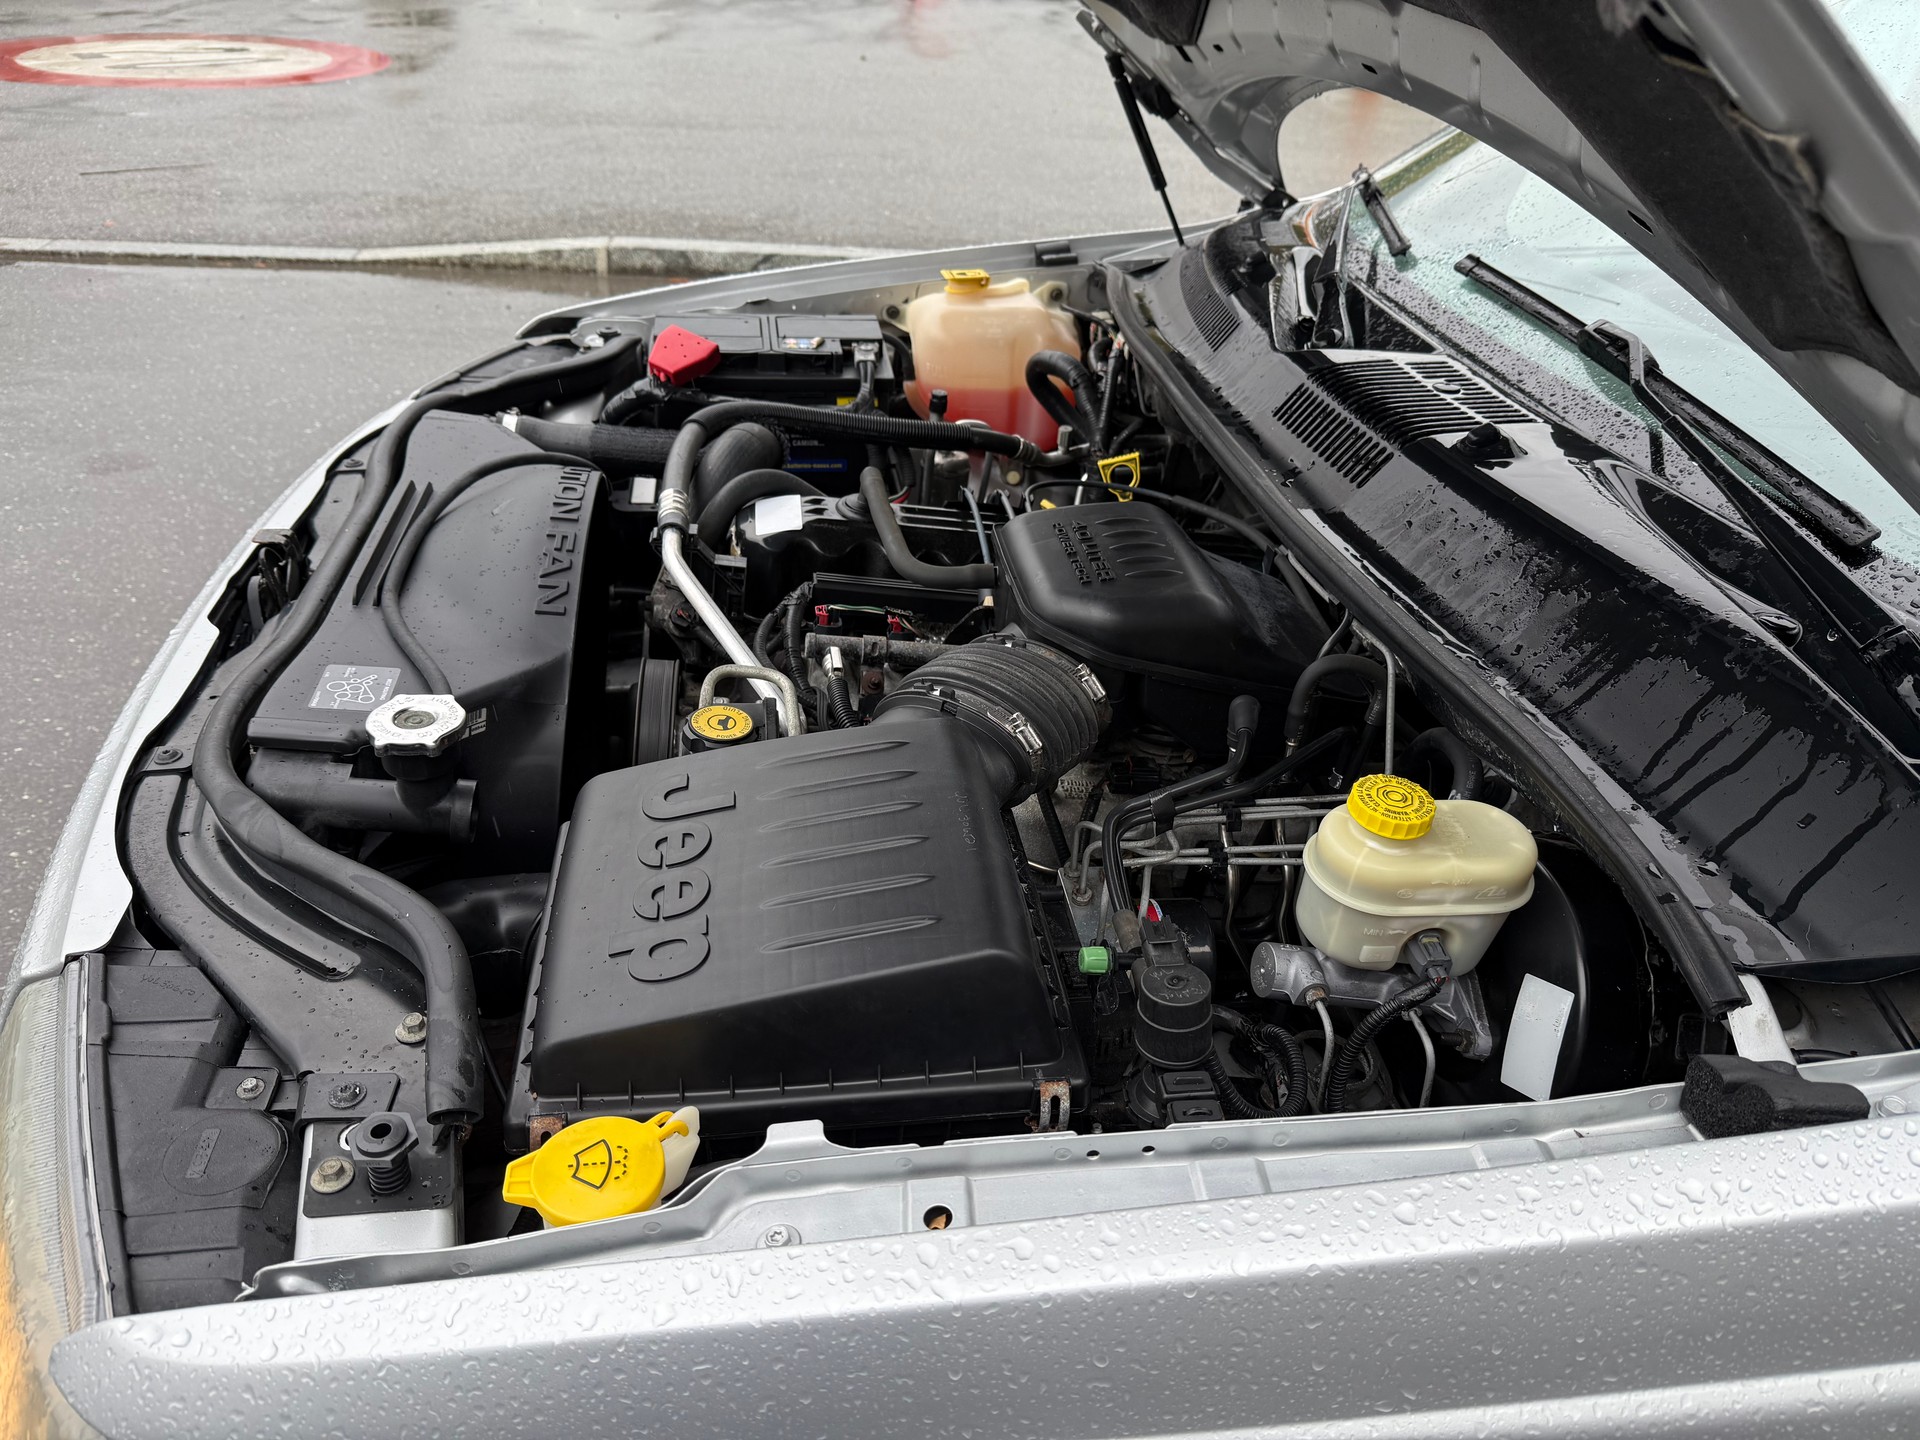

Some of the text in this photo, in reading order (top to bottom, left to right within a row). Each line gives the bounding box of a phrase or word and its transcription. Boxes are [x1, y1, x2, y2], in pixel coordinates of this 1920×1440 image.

[1053, 522, 1092, 584] POWER TECH
[1082, 544, 1117, 582] LITER
[534, 531, 576, 616] FAN
[1365, 792, 1380, 807] CLEAN
[1382, 807, 1409, 815] WARNING
[1380, 812, 1413, 821] ATTENTION
[608, 773, 736, 983] Jeep
[1364, 928, 1384, 936] MIN
